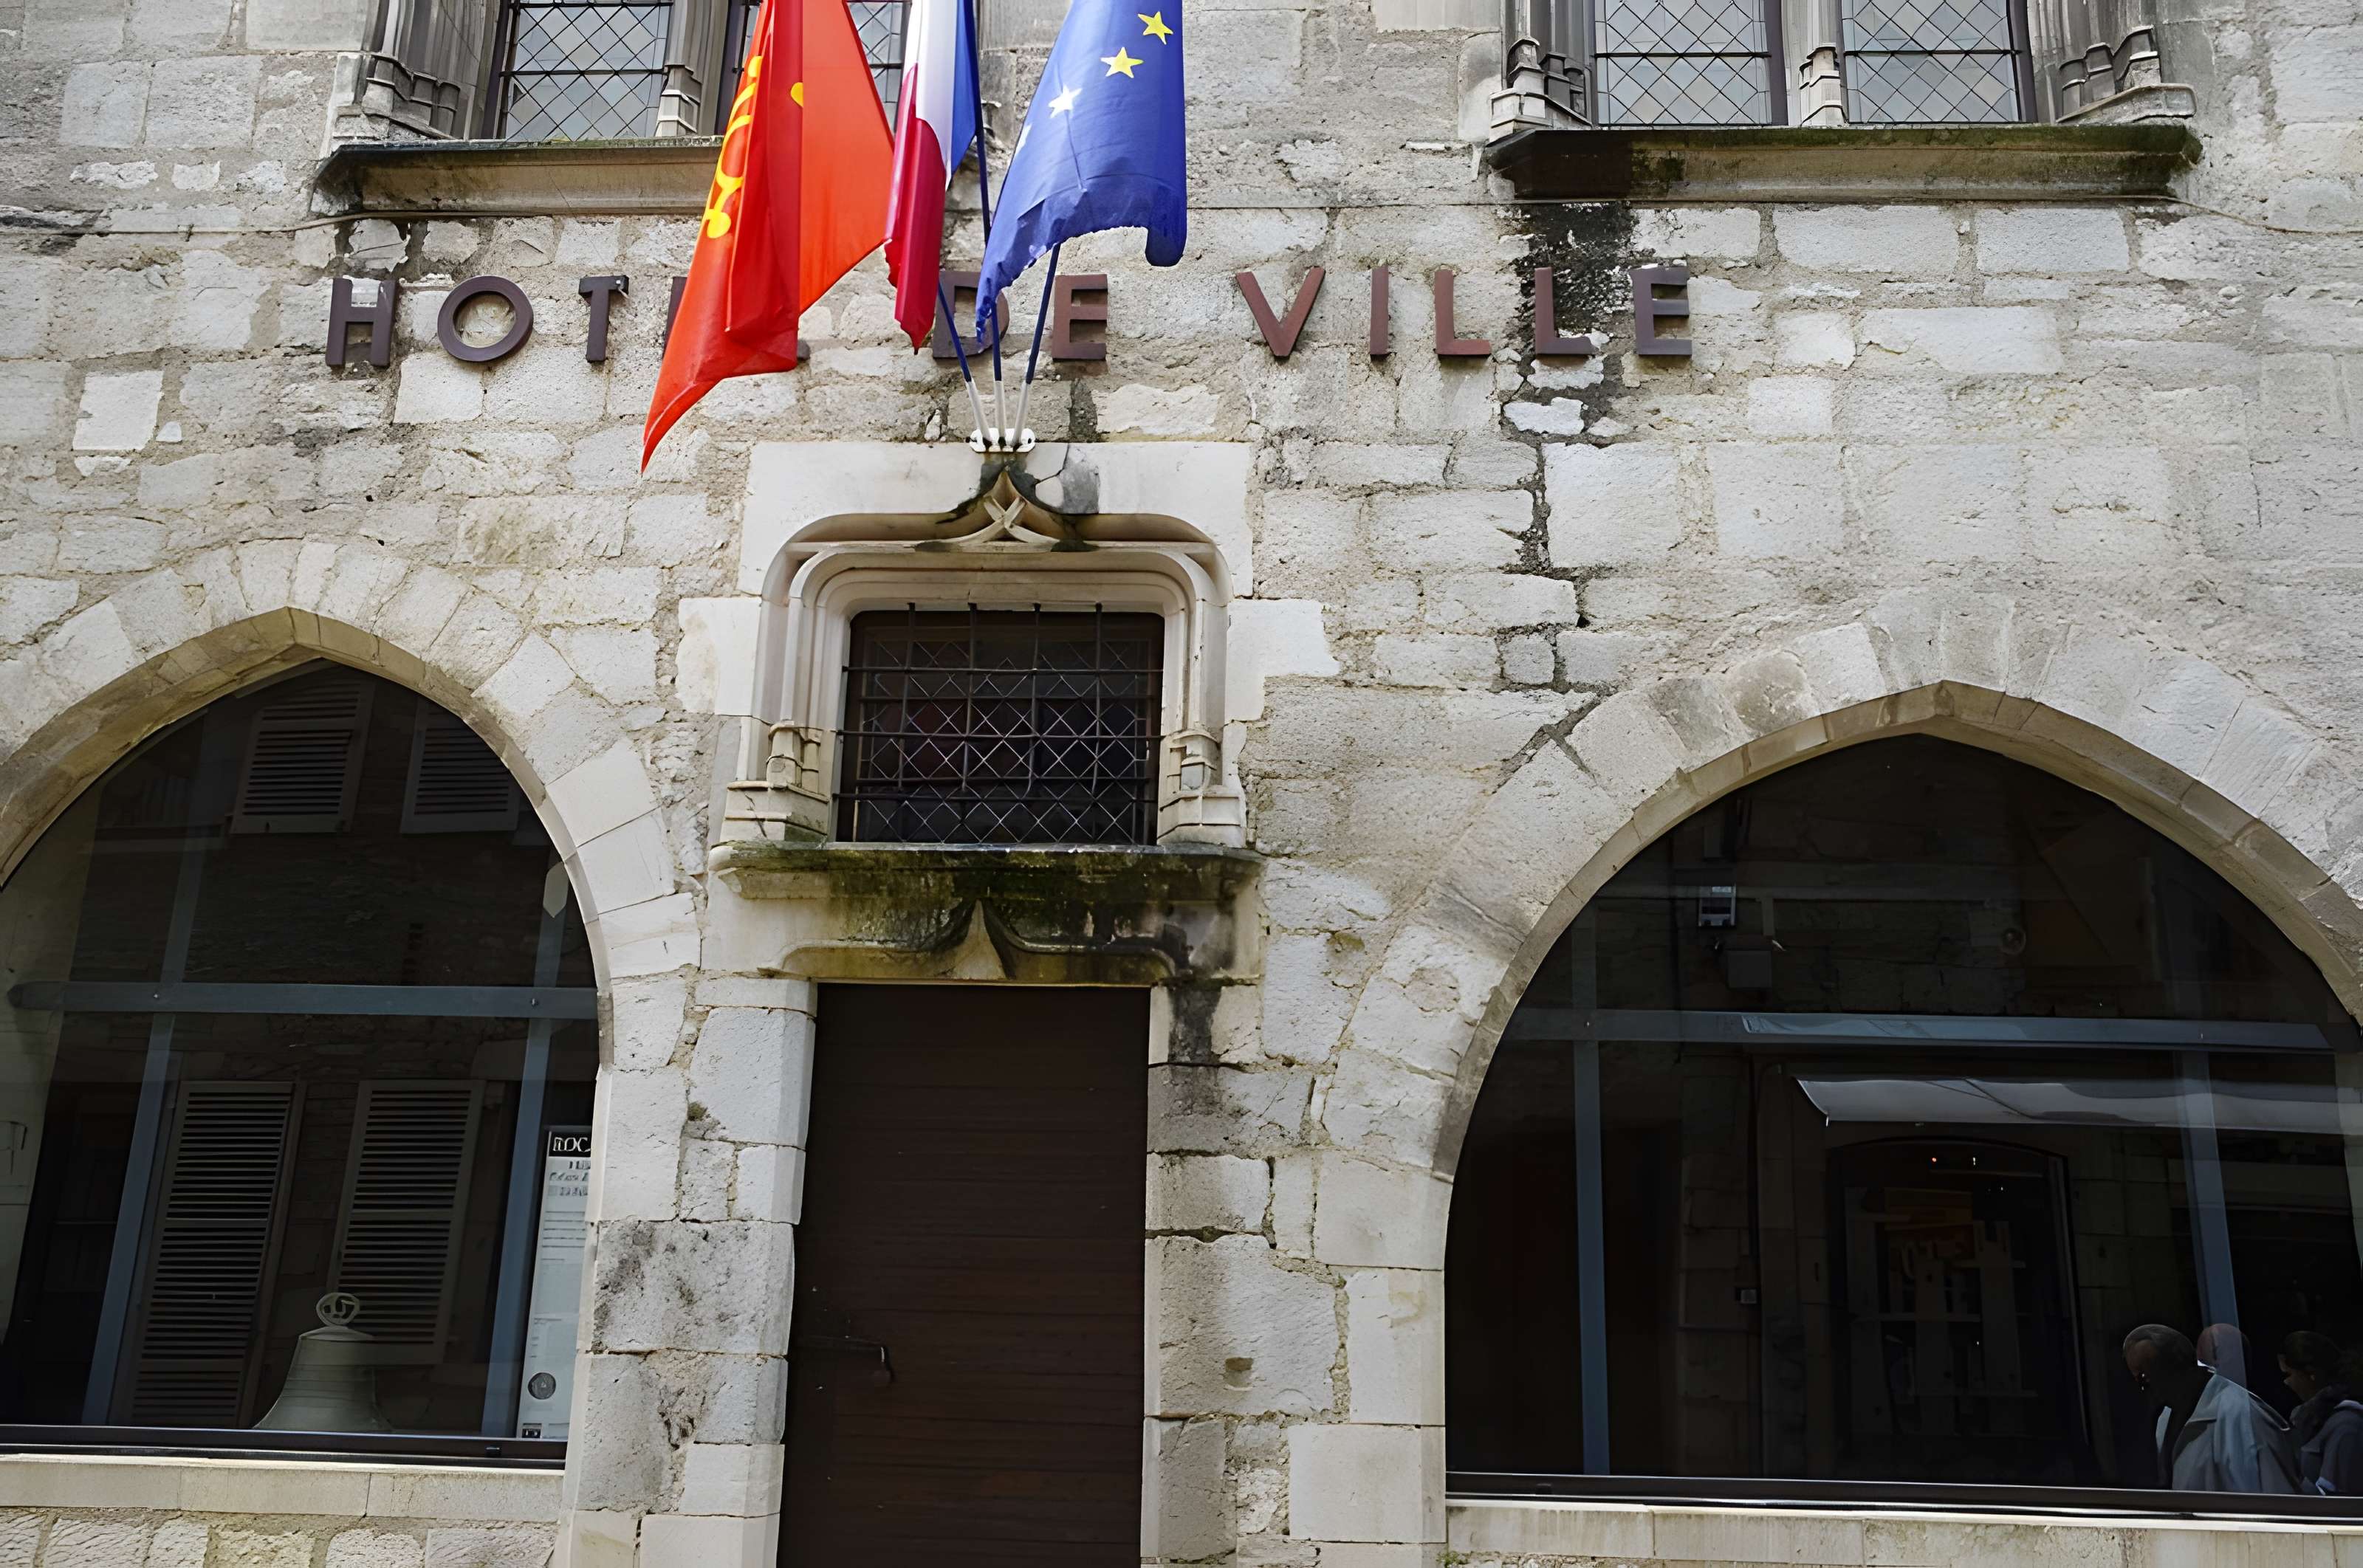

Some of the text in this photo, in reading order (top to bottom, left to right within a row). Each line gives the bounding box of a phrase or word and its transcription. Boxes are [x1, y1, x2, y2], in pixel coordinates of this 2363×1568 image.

[326, 266, 1692, 368] HOT DE VILLE
